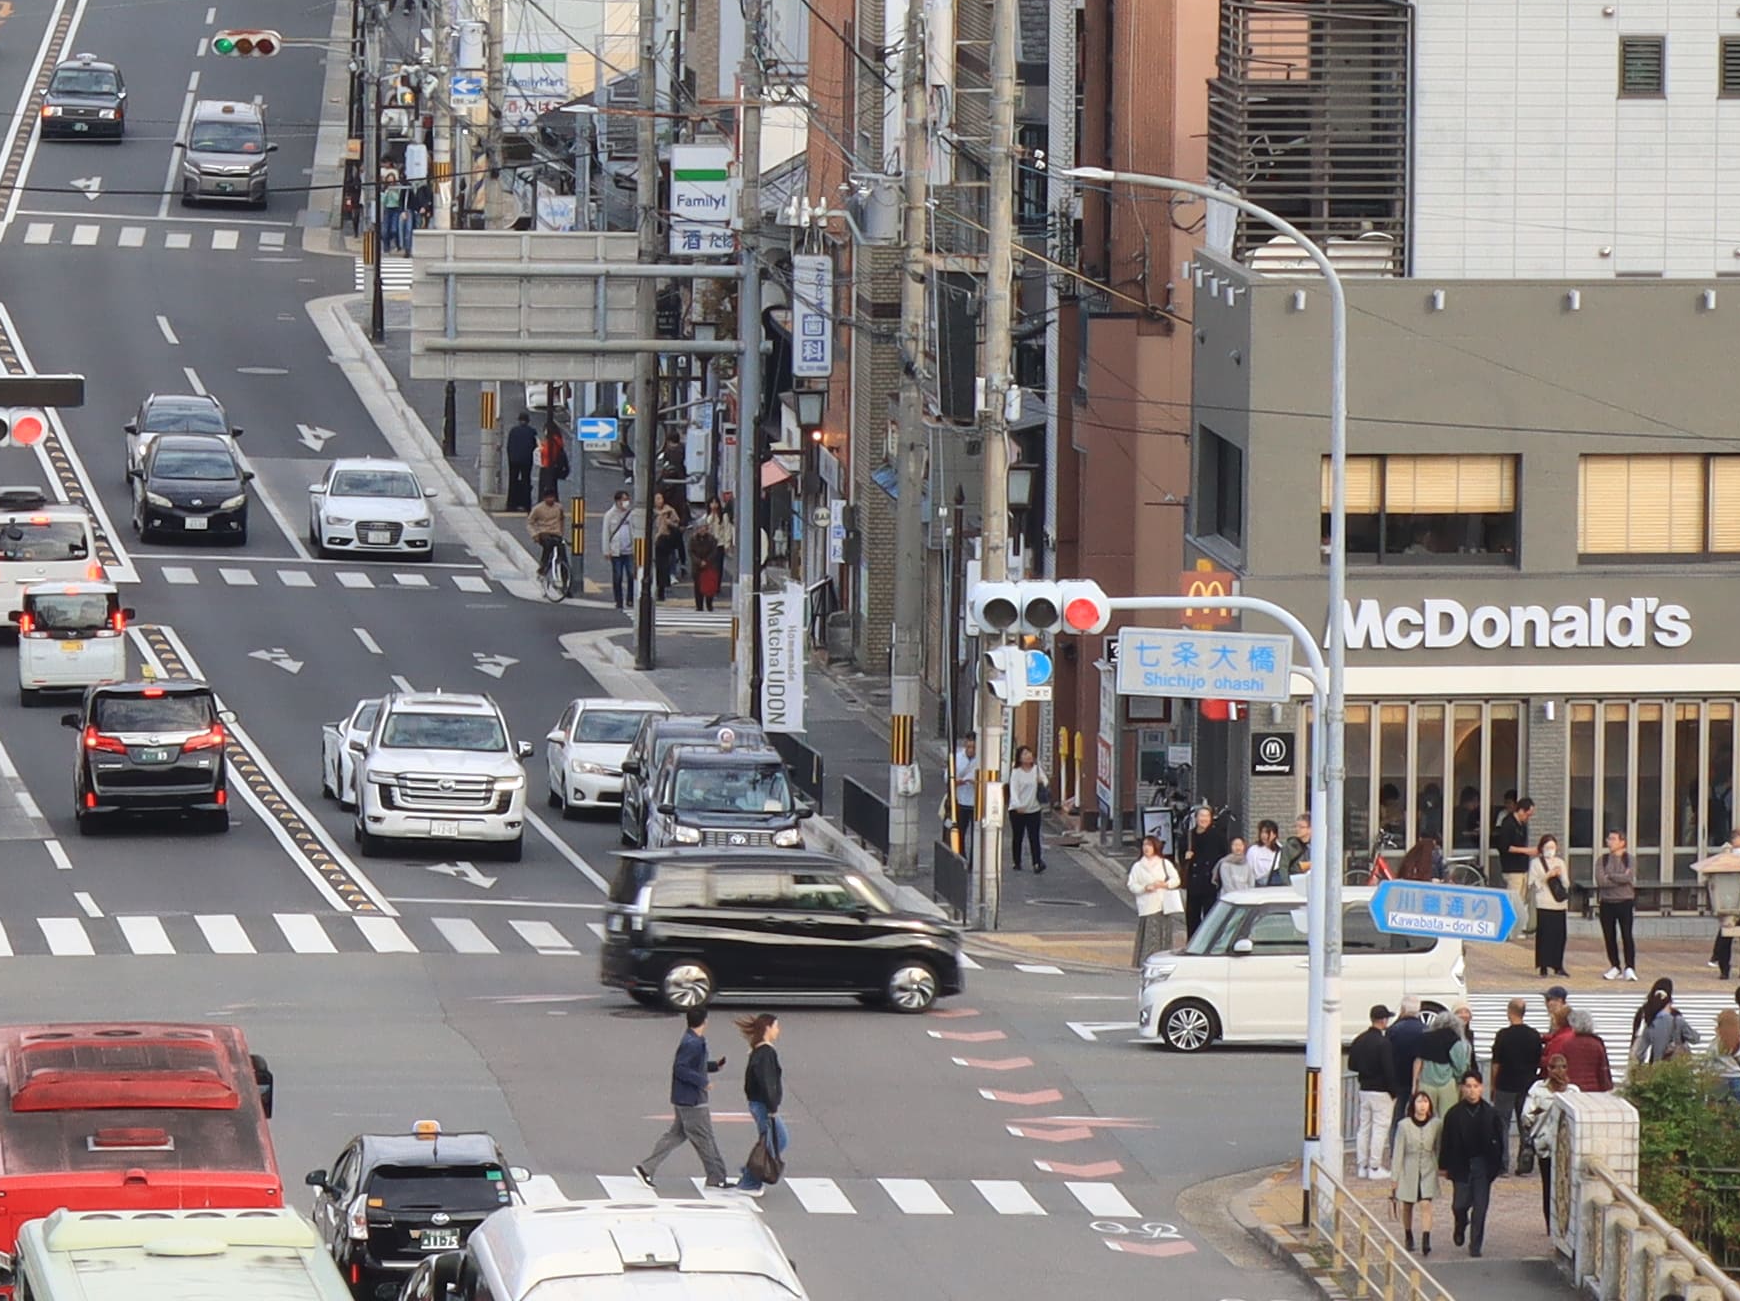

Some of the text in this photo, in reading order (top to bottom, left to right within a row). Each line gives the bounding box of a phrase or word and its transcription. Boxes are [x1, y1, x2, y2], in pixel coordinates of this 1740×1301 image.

[682, 229, 701, 250] 酒
[1322, 597, 1693, 650] McDonald's
[1135, 640, 1276, 674] 七条大橋
[766, 671, 787, 726] UDON
[1143, 672, 1265, 692] Shichijo ohashi
